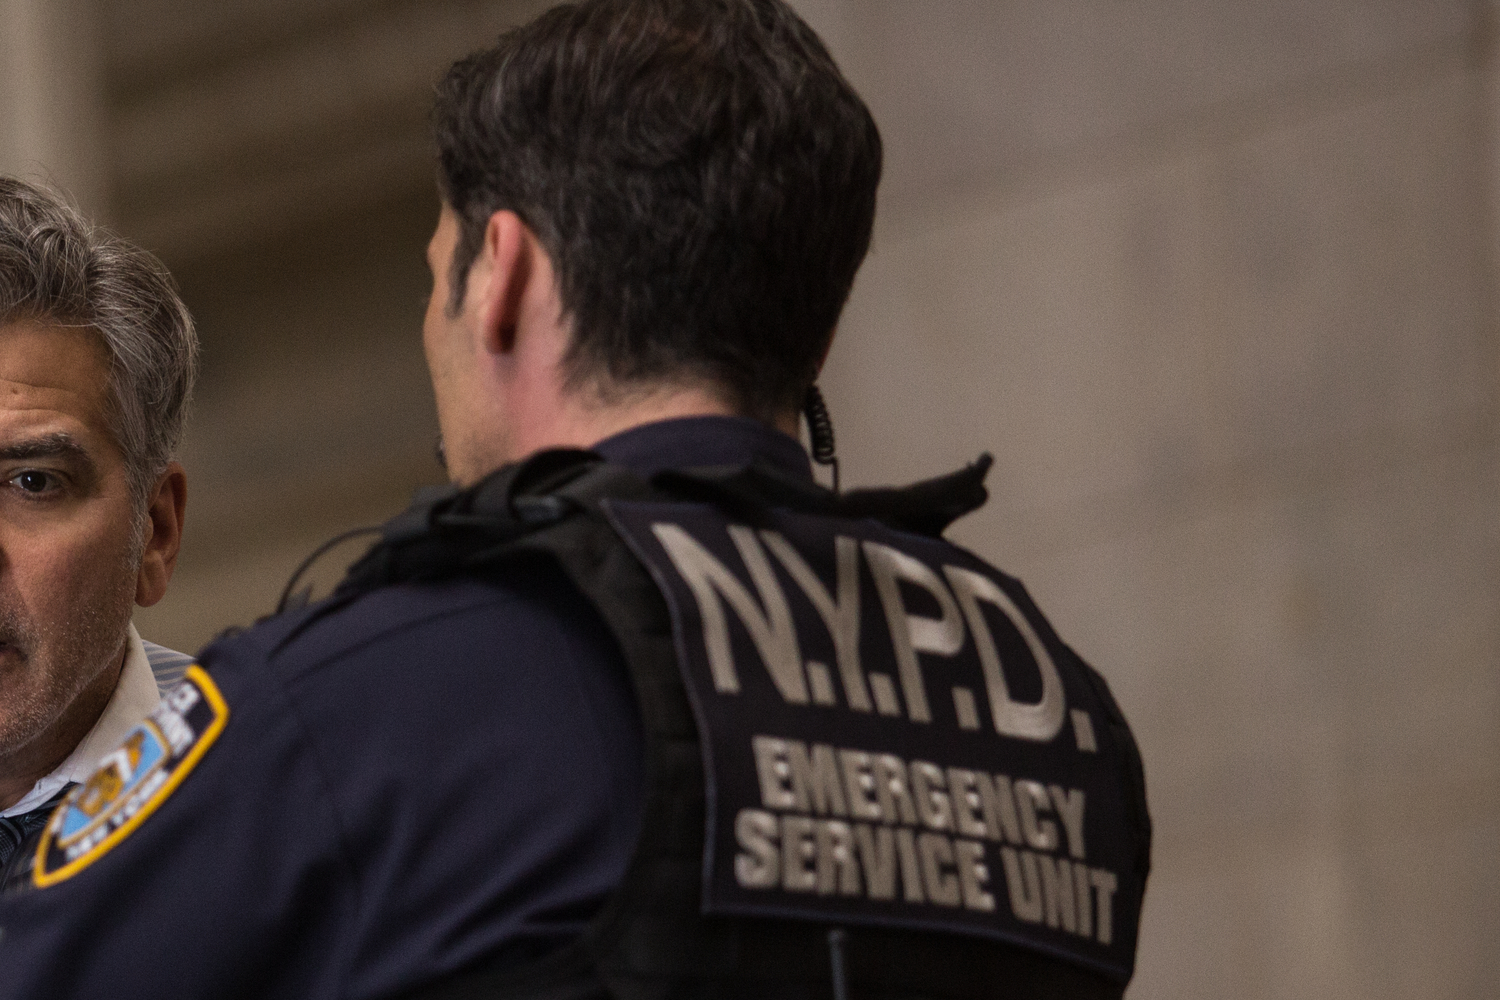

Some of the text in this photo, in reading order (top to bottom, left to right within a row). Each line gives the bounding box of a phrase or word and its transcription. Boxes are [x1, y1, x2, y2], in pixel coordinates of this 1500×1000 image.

[651, 522, 1098, 752] N.Y.P.D.
[752, 736, 1086, 858] EMERGENCY
[734, 808, 1117, 945] SERVICE UNIT
